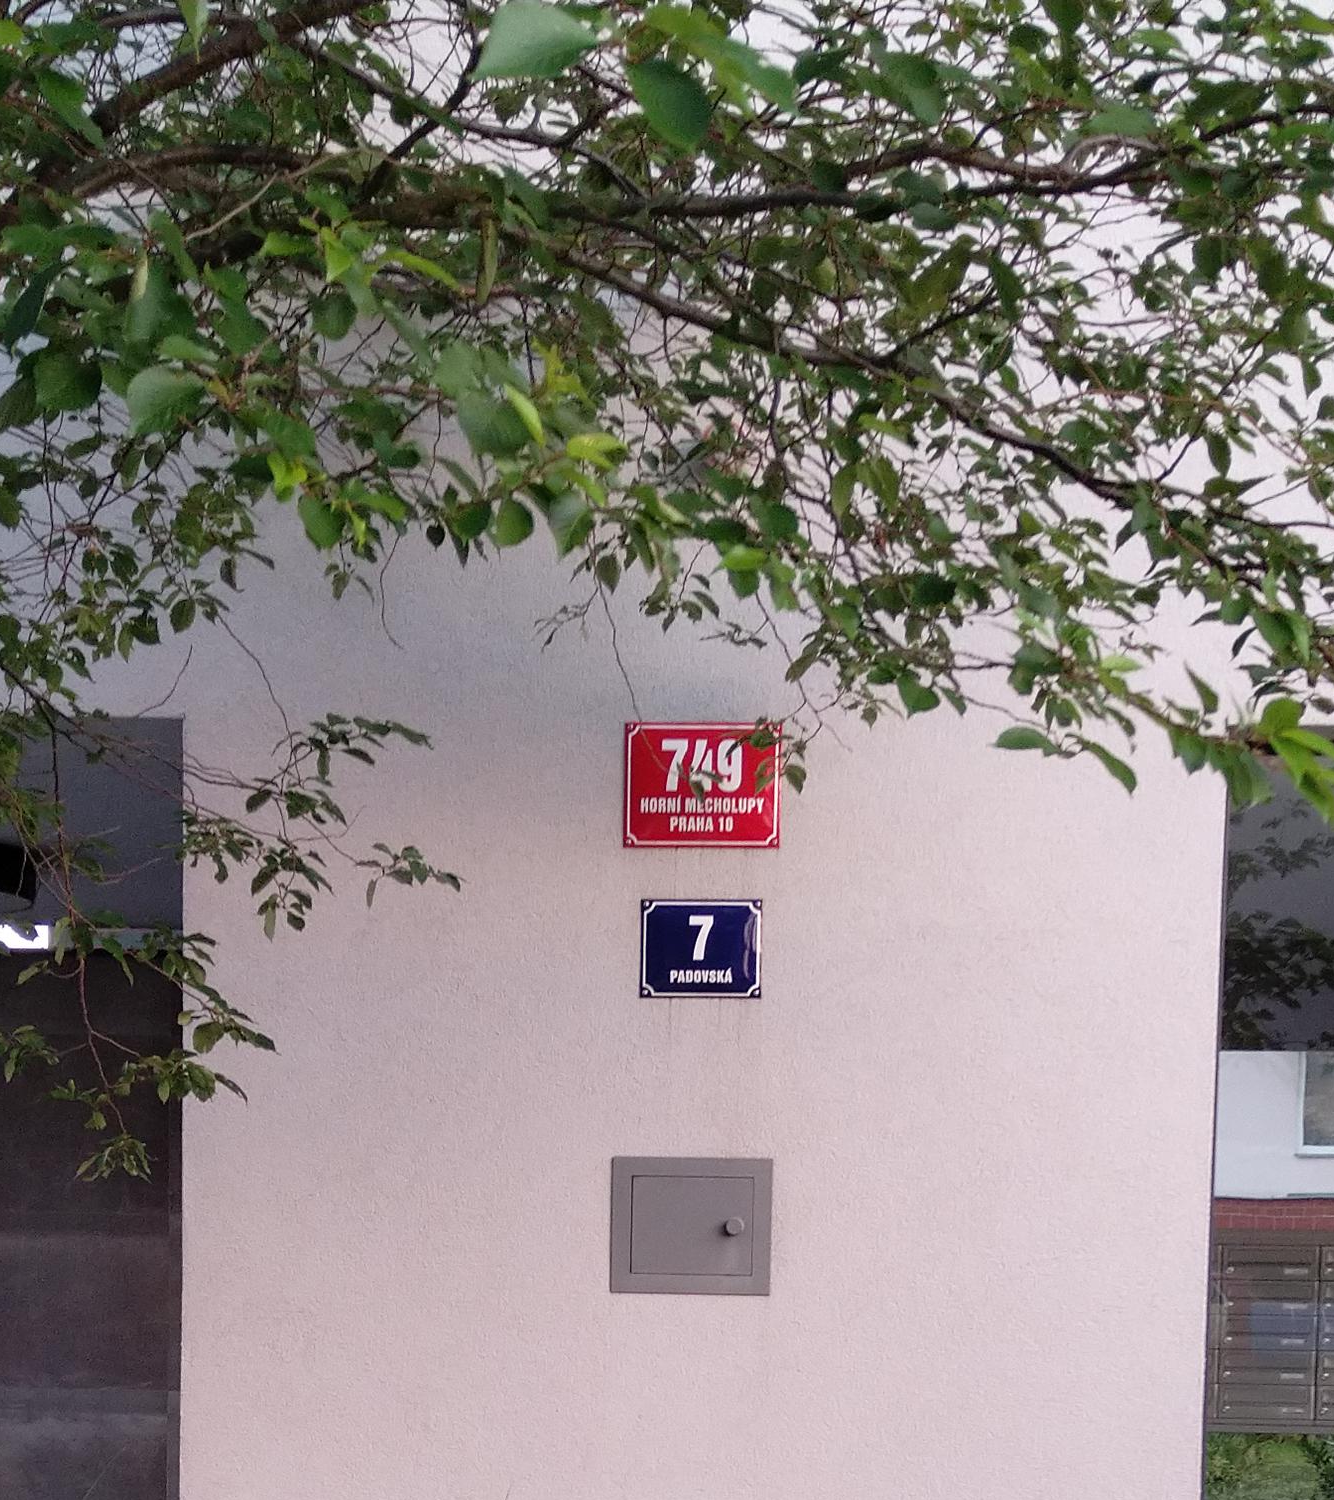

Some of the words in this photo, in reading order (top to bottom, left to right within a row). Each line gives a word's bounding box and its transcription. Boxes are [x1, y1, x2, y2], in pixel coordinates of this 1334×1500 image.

[661, 738, 744, 793] 749
[640, 794, 682, 814] HORNÍ
[669, 815, 715, 833] PRAHA
[718, 816, 734, 833] 10
[688, 914, 715, 962] 7
[669, 966, 733, 984] PADOVSKÁ
